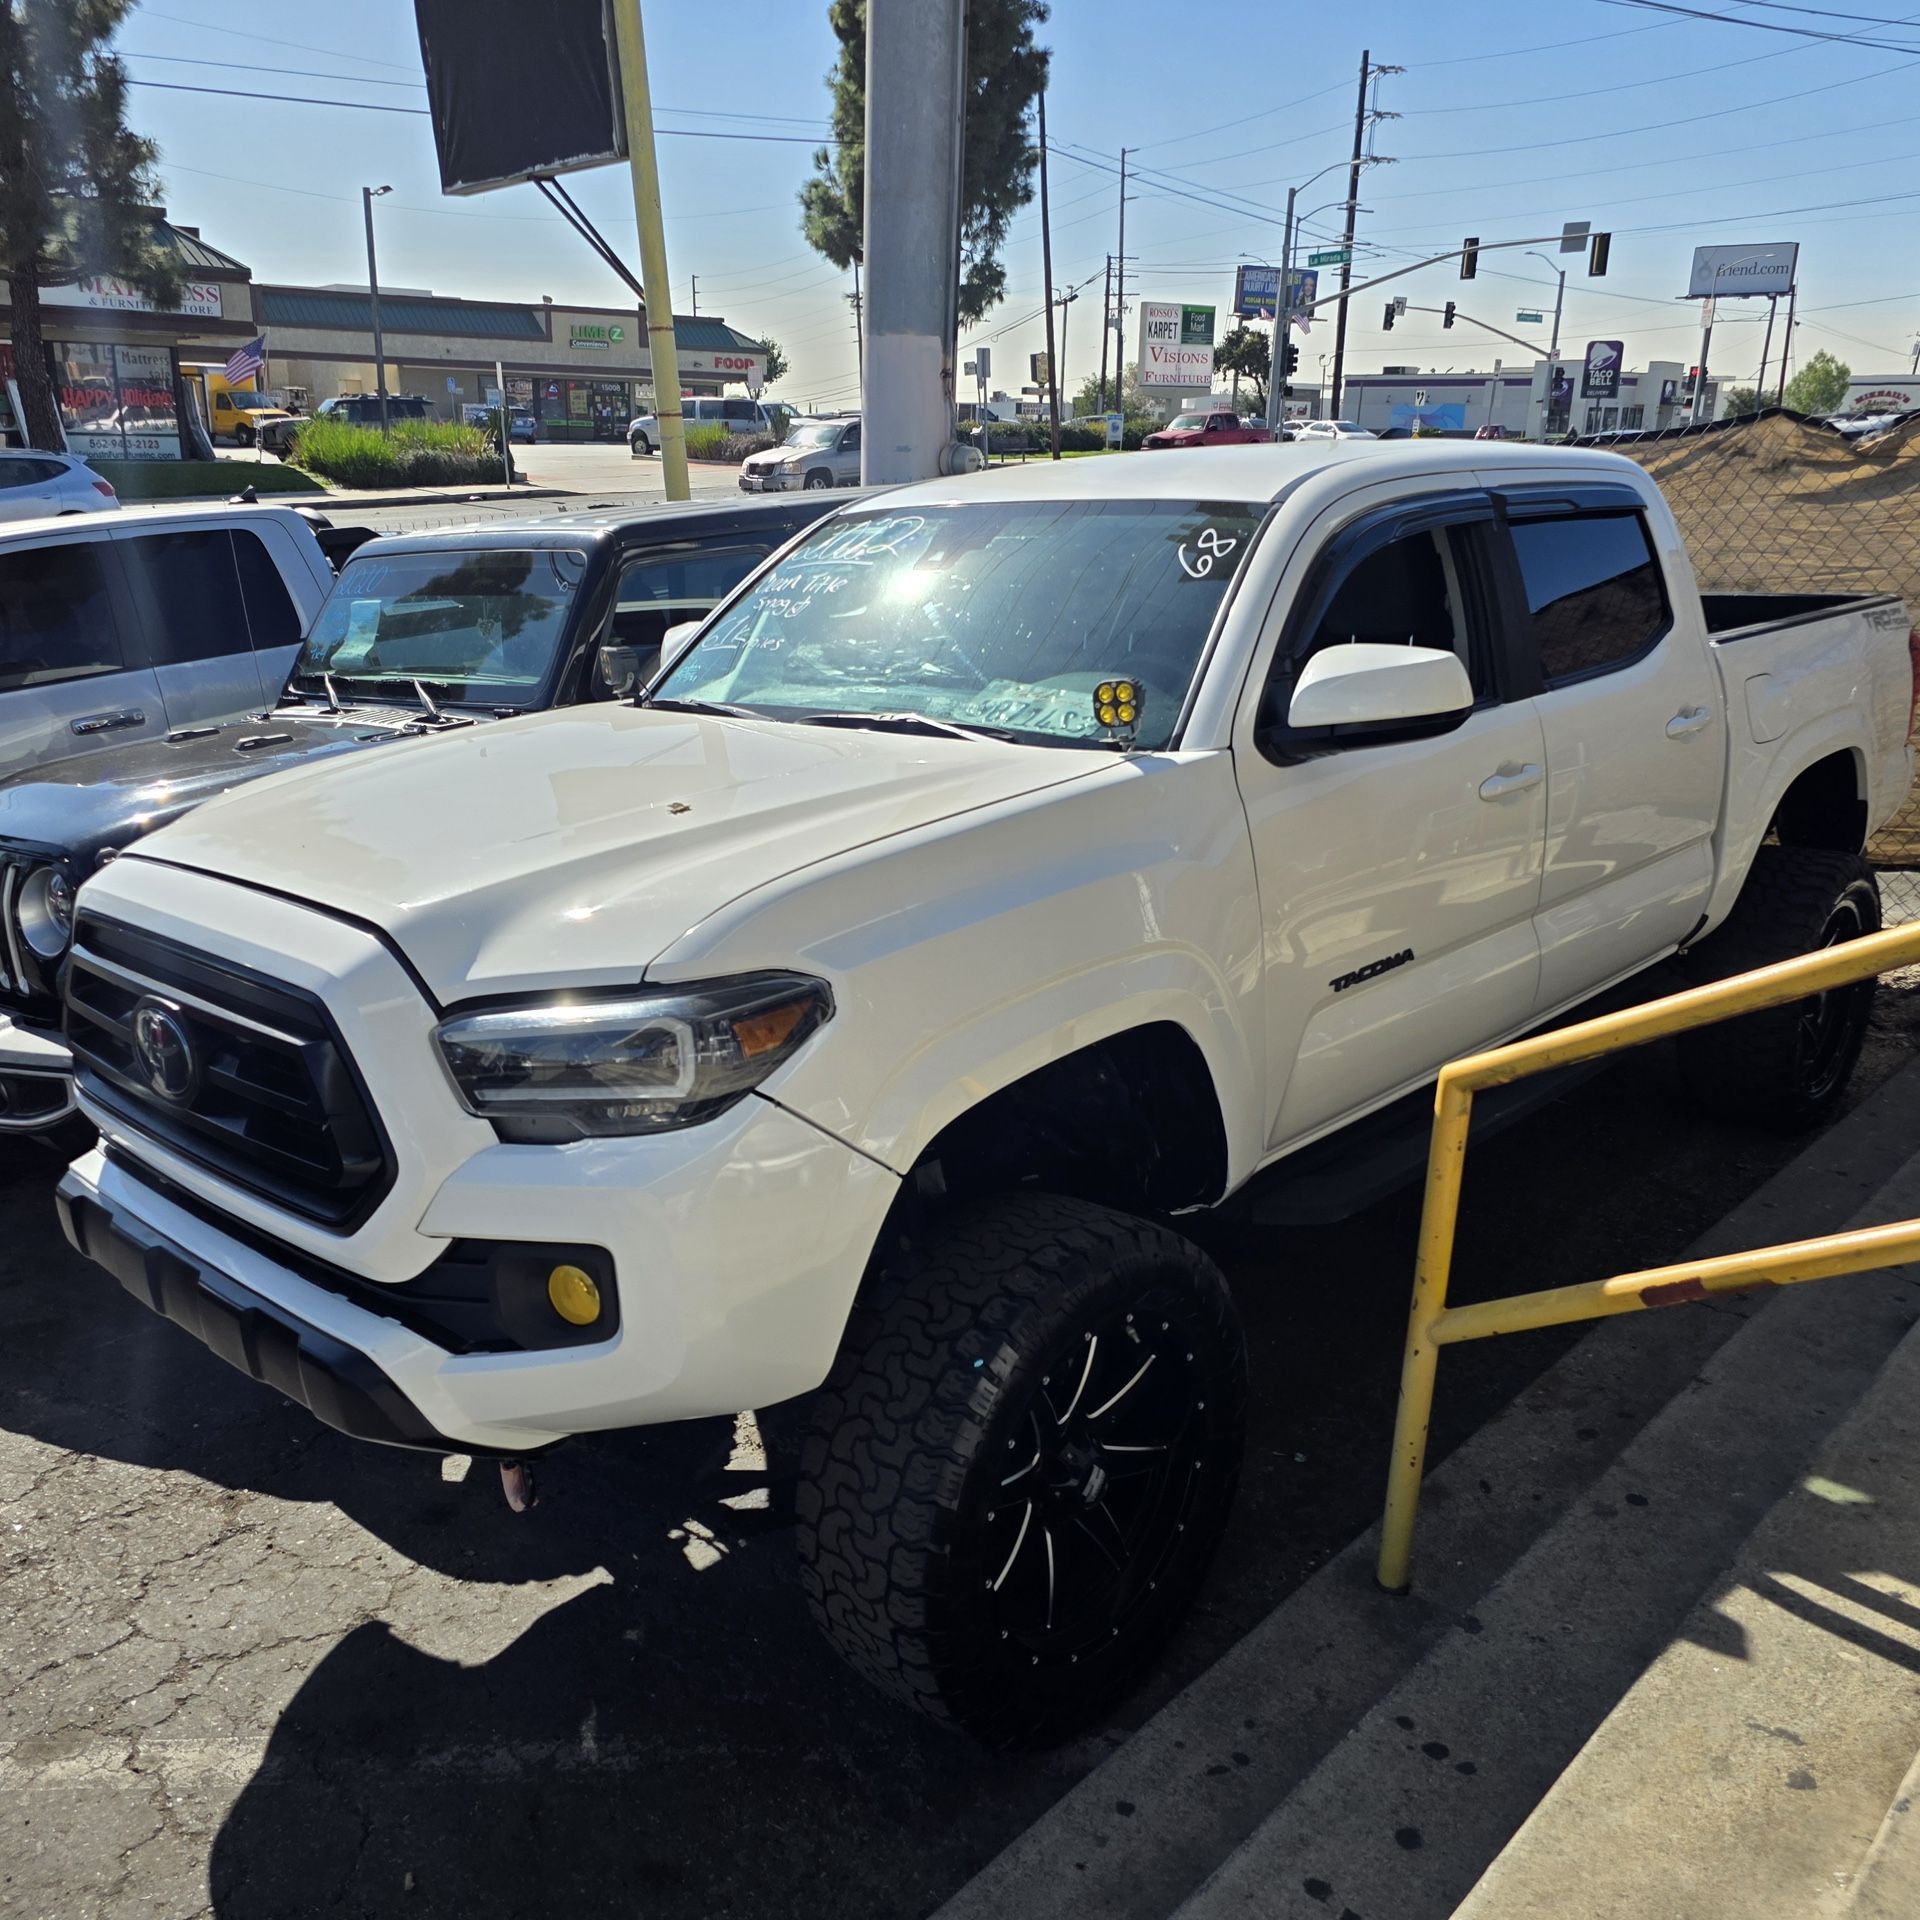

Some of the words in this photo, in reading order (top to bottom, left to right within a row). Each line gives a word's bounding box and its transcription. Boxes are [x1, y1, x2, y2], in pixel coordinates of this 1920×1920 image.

[1716, 262, 1790, 277] friend.com
[88, 298, 97, 306] &
[1149, 307, 1179, 319] ROSSO'S
[1190, 312, 1206, 322] Food
[570, 325, 606, 339] LIME
[1147, 321, 1178, 340] KARPET
[1190, 322, 1205, 332] Mart
[121, 351, 170, 367] Mattress
[1150, 346, 1209, 364] VISIONS
[1145, 371, 1212, 384] FURNITURE
[1590, 370, 1613, 378] TACO
[1589, 378, 1612, 386] BELL
[62, 385, 115, 409] HAPPY
[1178, 528, 1237, 578] 68
[1328, 948, 1415, 993] TACOMA
